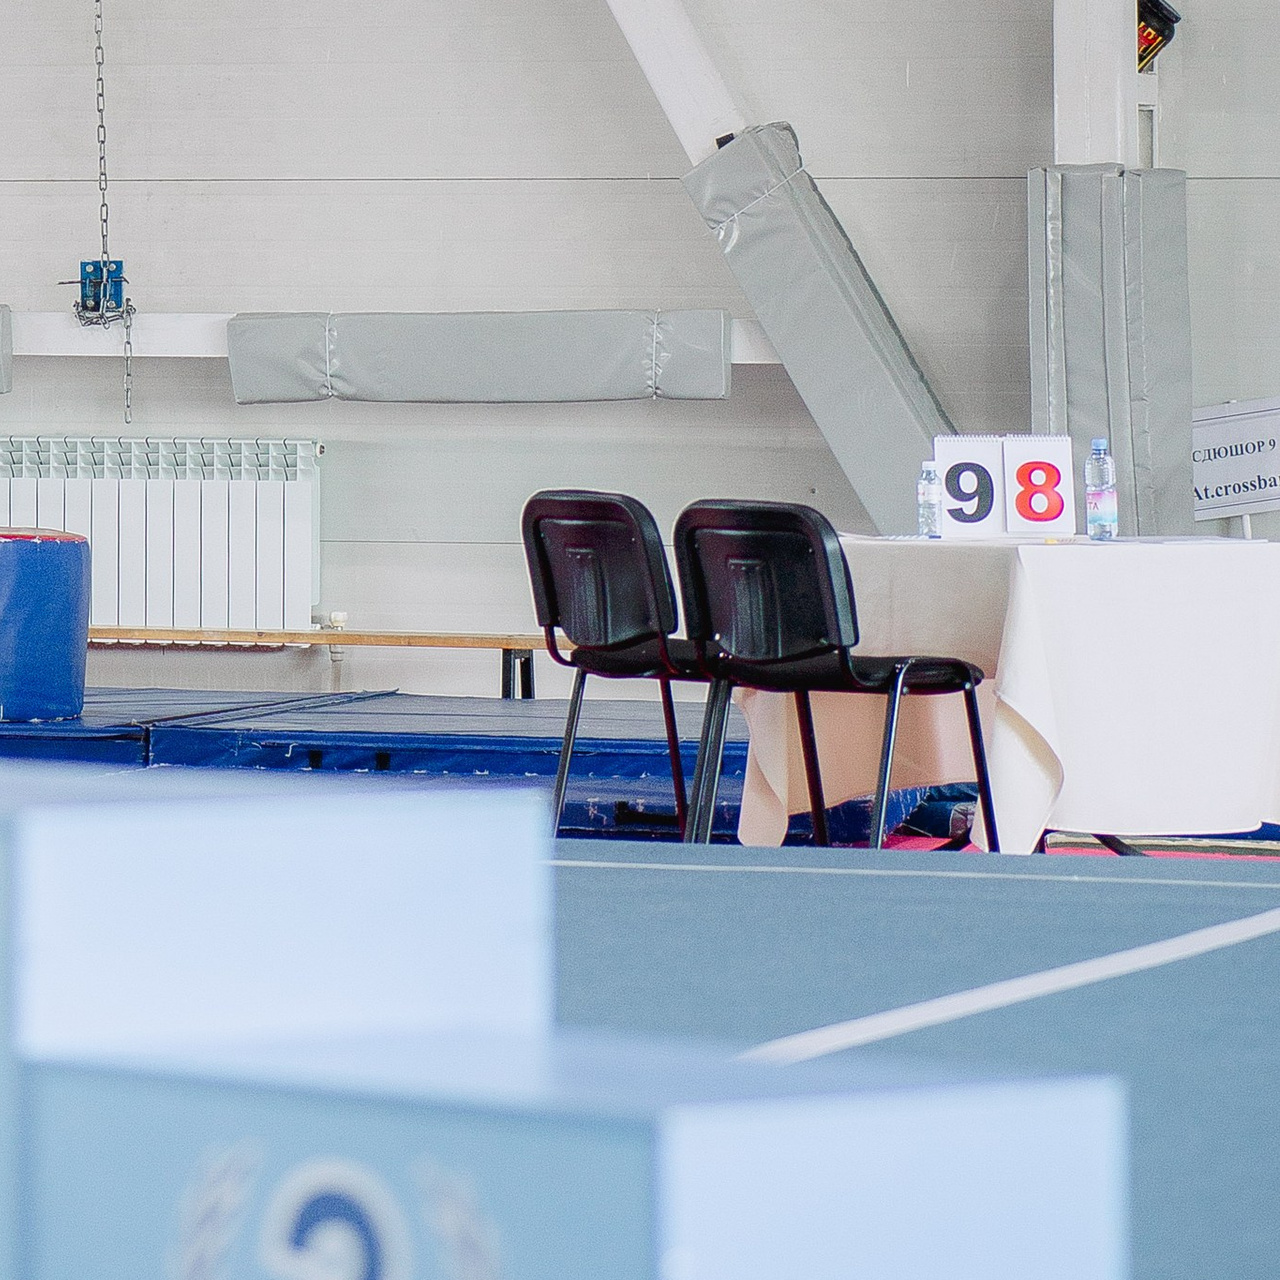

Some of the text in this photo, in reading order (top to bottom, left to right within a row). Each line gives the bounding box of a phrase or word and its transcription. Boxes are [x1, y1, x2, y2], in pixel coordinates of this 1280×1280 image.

[1192, 438, 1276, 463] СДЮШОР 9
[944, 460, 1065, 524] 9 8
[1193, 474, 1280, 501] At.crossba
